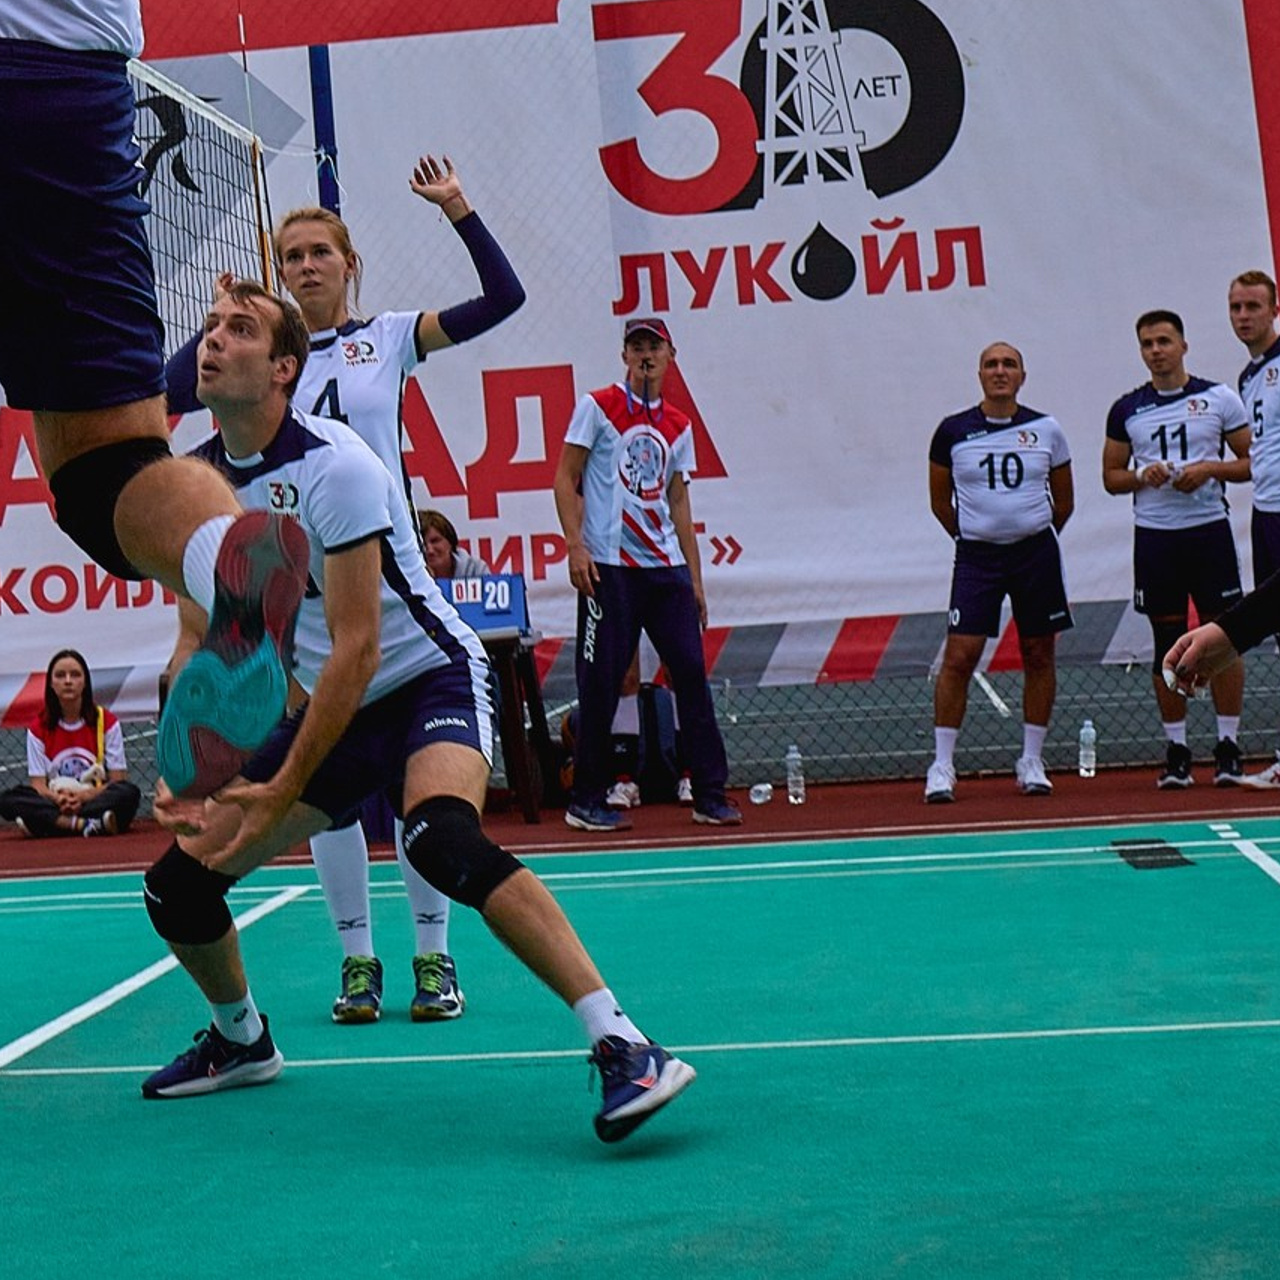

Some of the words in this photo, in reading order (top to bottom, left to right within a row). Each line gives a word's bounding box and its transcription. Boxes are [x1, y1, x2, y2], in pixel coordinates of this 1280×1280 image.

[853, 75, 902, 100] ЛЕТ
[311, 377, 349, 425] 4
[1253, 400, 1264, 438] 5
[1151, 423, 1188, 461] 11
[979, 451, 1024, 490] 10
[486, 581, 510, 609] 20
